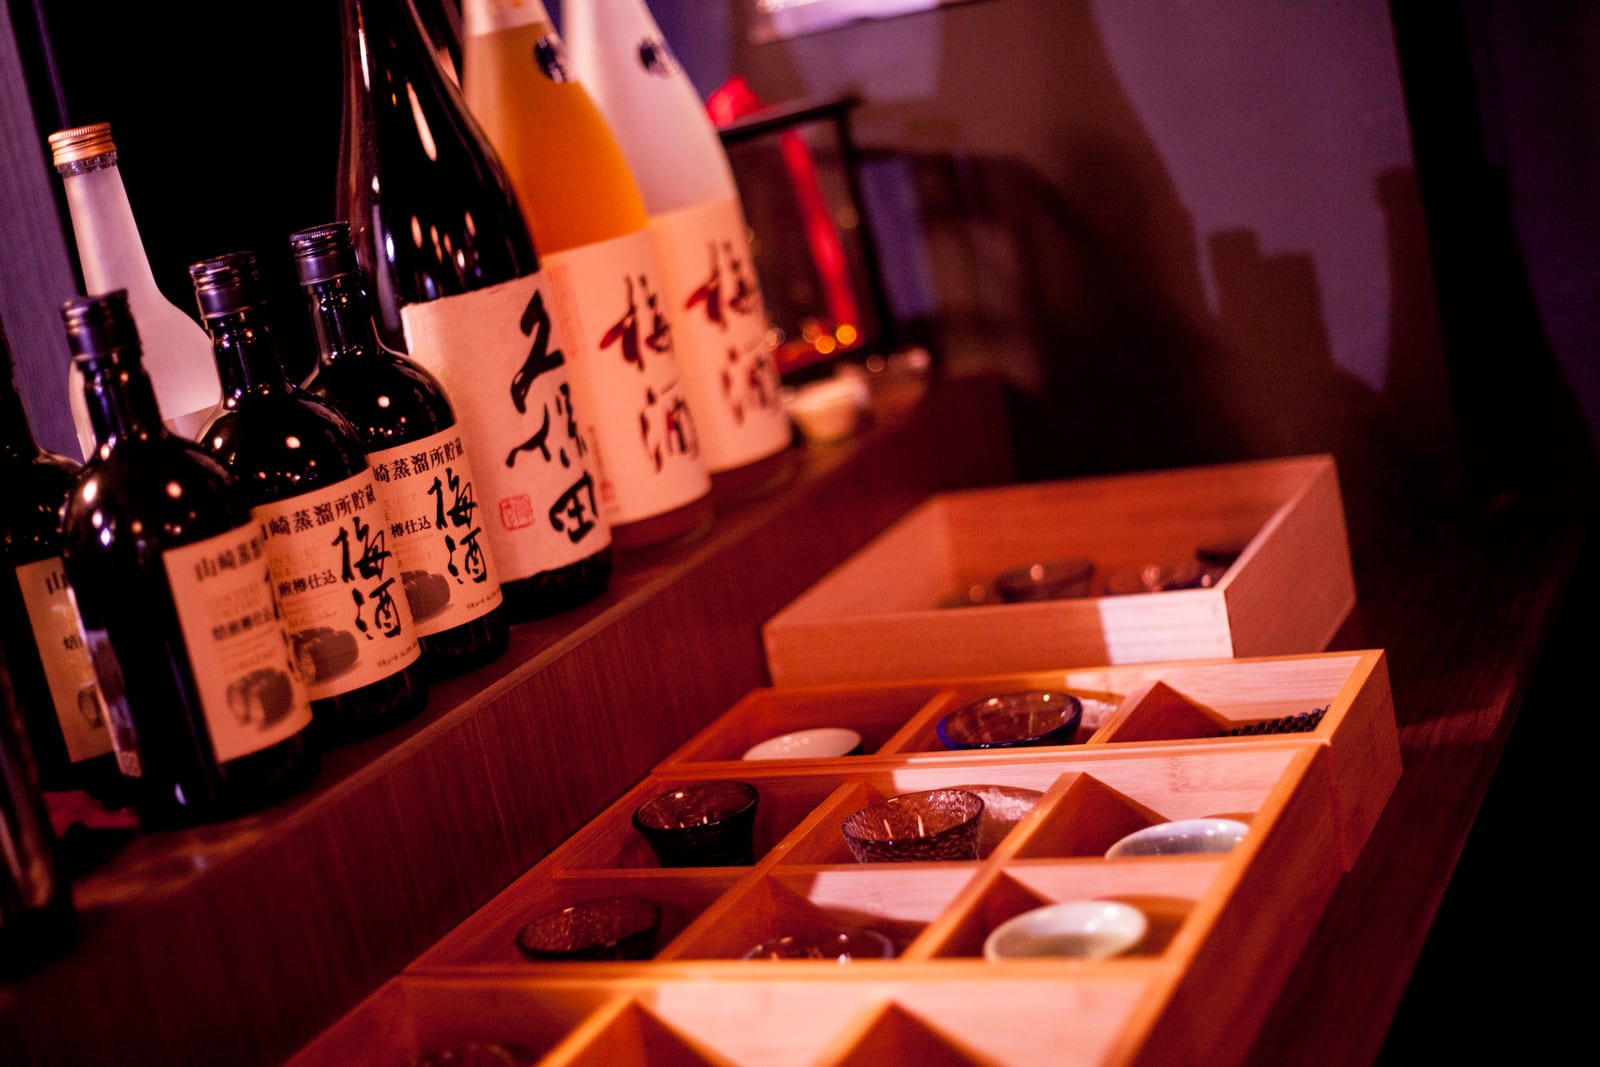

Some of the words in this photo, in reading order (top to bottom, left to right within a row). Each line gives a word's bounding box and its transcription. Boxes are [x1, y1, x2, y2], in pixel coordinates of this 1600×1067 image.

[599, 273, 700, 474] 梅酒
[331, 516, 402, 640] 梅酒
[427, 467, 488, 585] 梅酒
